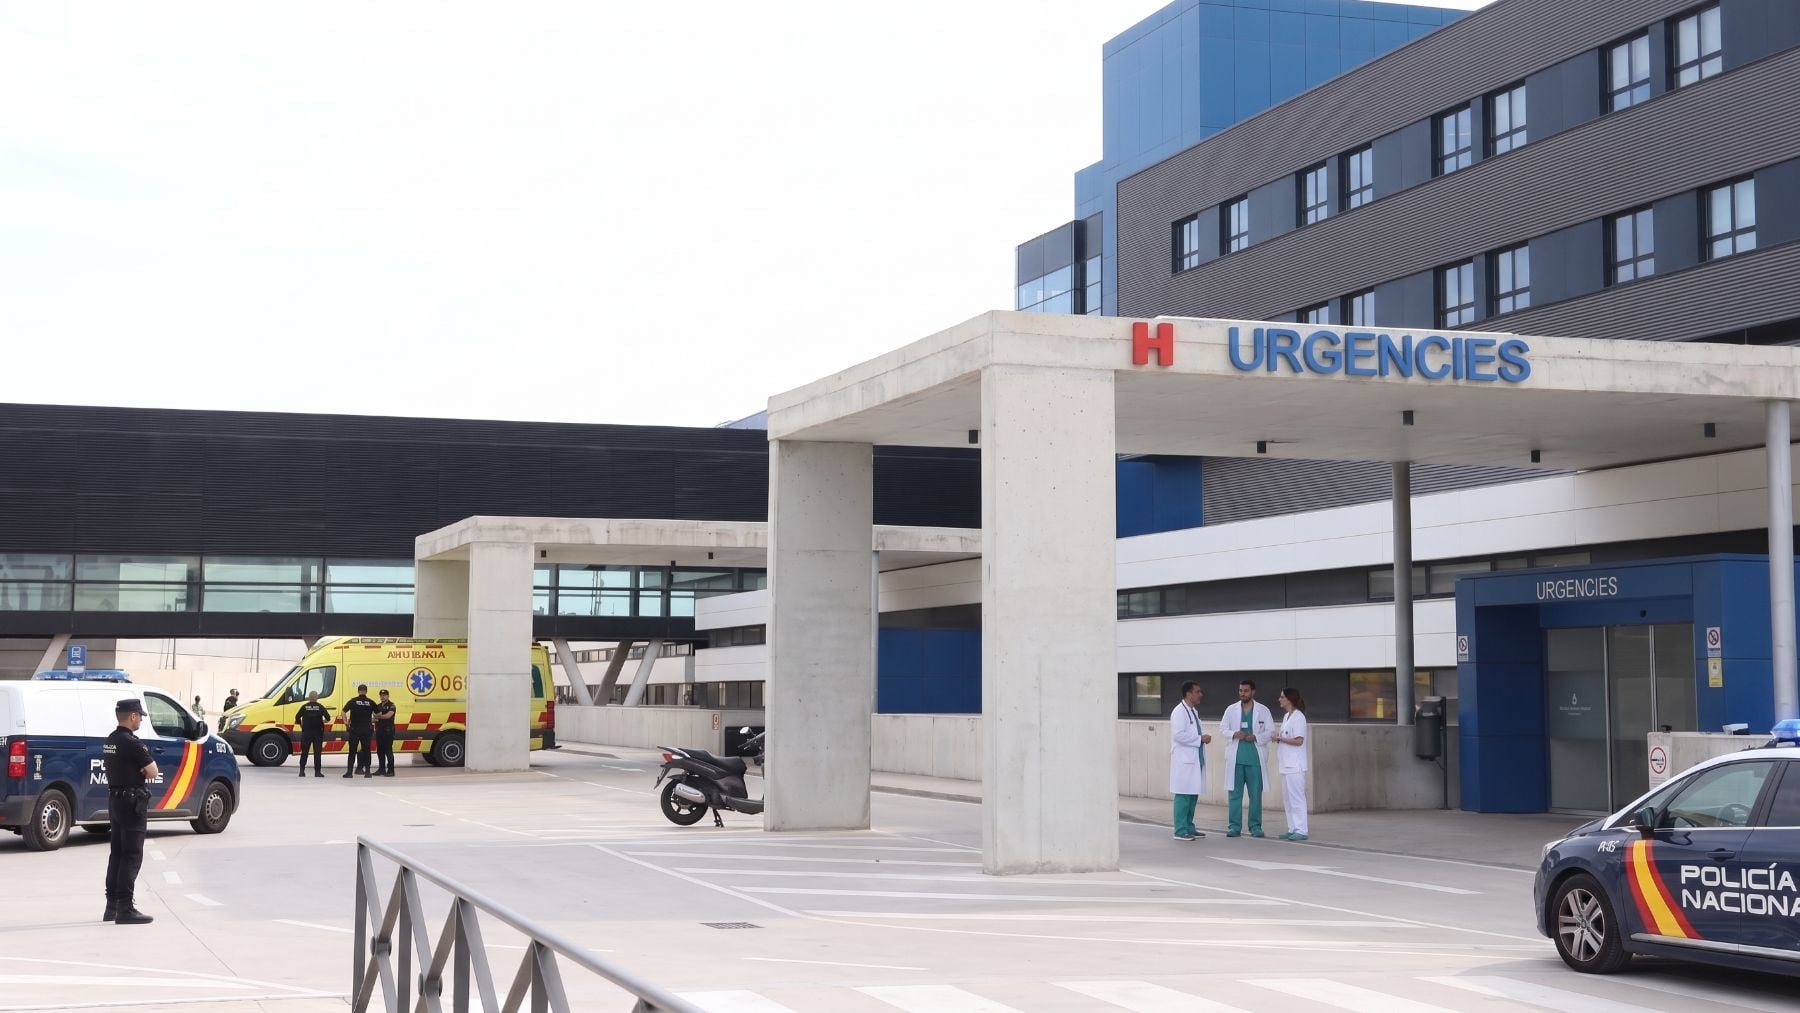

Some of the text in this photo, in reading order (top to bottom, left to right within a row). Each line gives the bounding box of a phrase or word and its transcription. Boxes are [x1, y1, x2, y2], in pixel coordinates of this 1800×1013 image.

[1132, 321, 1532, 384] H URGENCIES
[1536, 576, 1618, 600] URGENCIES
[440, 674, 467, 692] 06
[1680, 862, 1798, 892] POLICÍA
